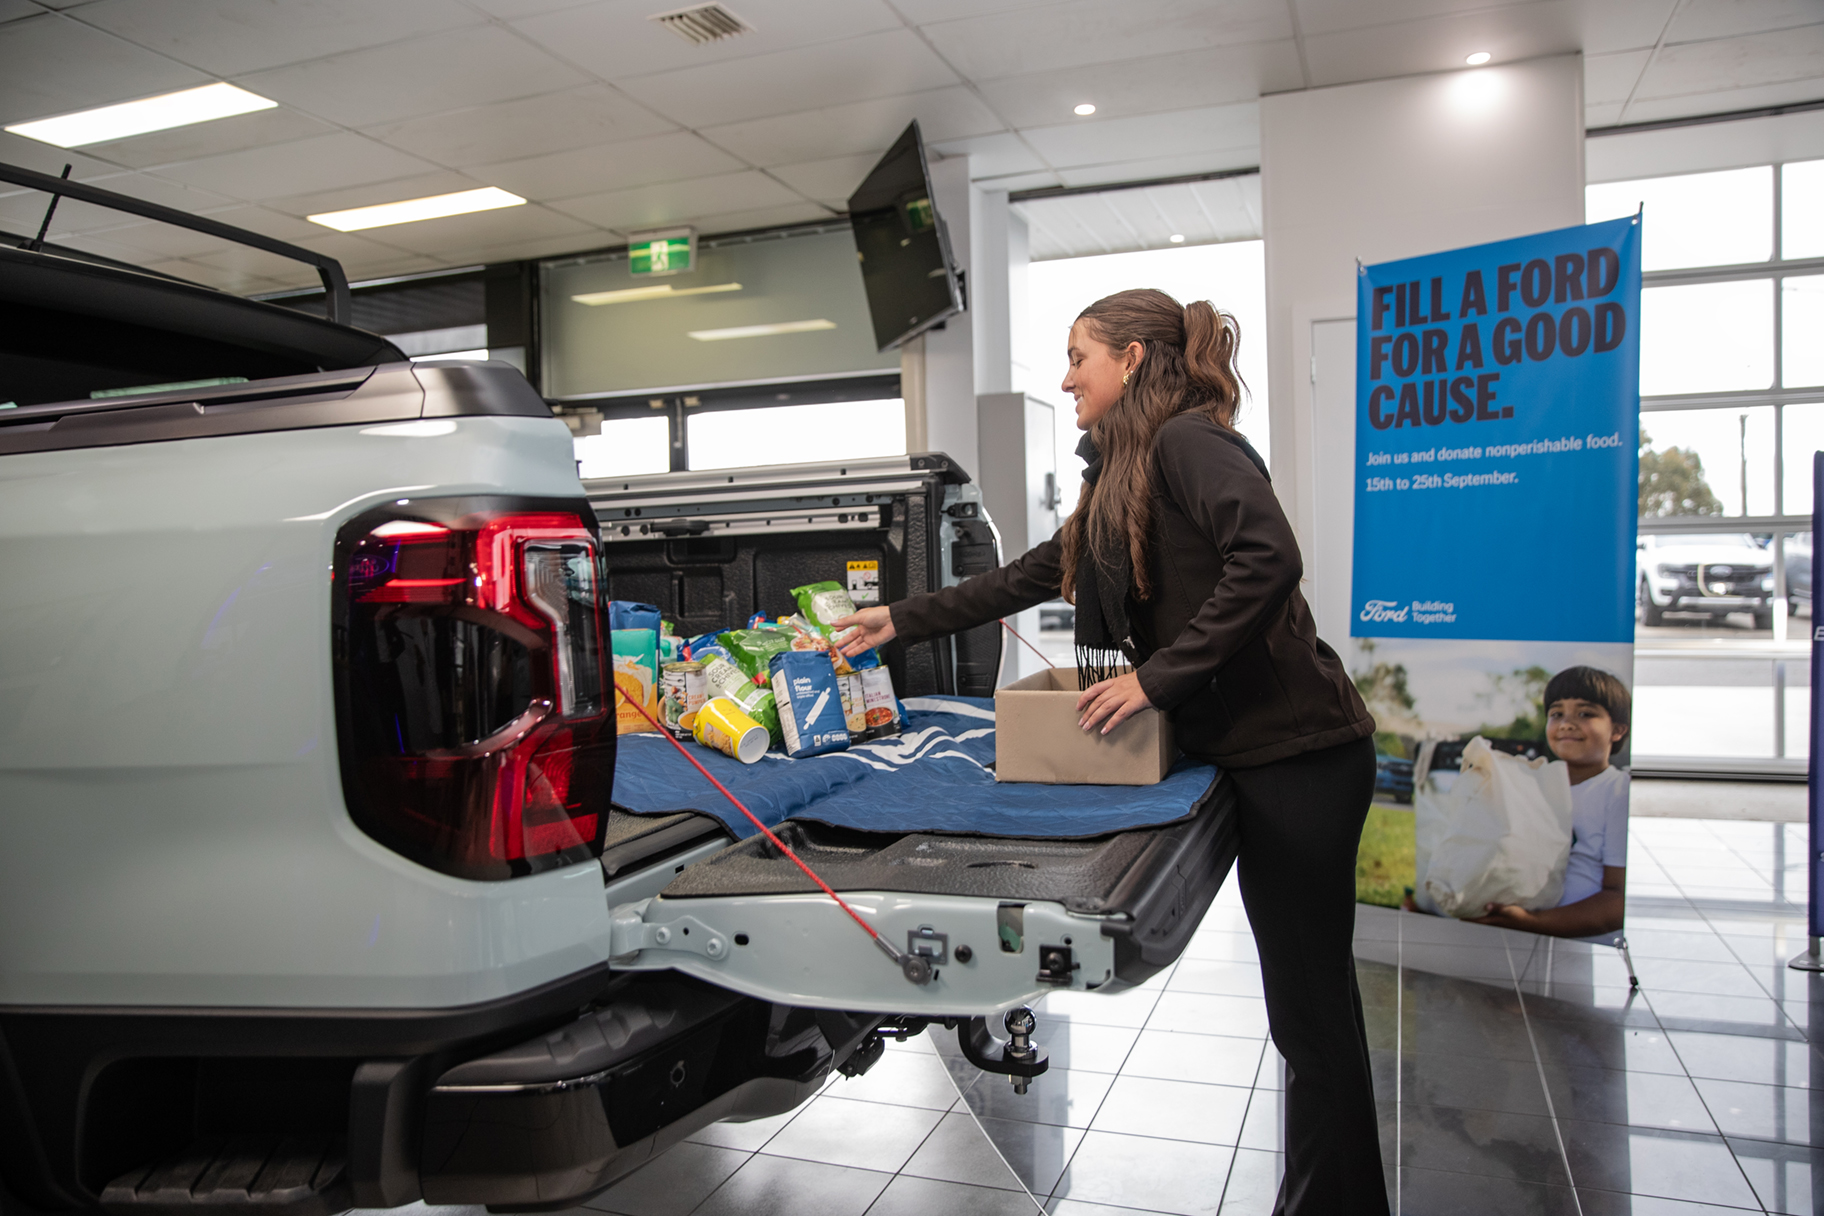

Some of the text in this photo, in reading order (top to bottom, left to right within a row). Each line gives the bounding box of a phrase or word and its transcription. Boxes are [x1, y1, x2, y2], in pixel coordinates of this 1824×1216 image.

[1371, 247, 1621, 331] FILL A FORD
[1369, 301, 1626, 381] FOR A GOOD
[1368, 372, 1515, 431] CAUSE.
[1366, 431, 1624, 466] Join us and donate nonperishable food.
[1365, 469, 1520, 492] 15th to 25th September.
[1359, 599, 1410, 623] Ford
[1411, 600, 1454, 614] Building
[1411, 611, 1457, 625] Together
[793, 676, 812, 686] plain
[794, 685, 813, 693] flour
[616, 710, 642, 719] range
